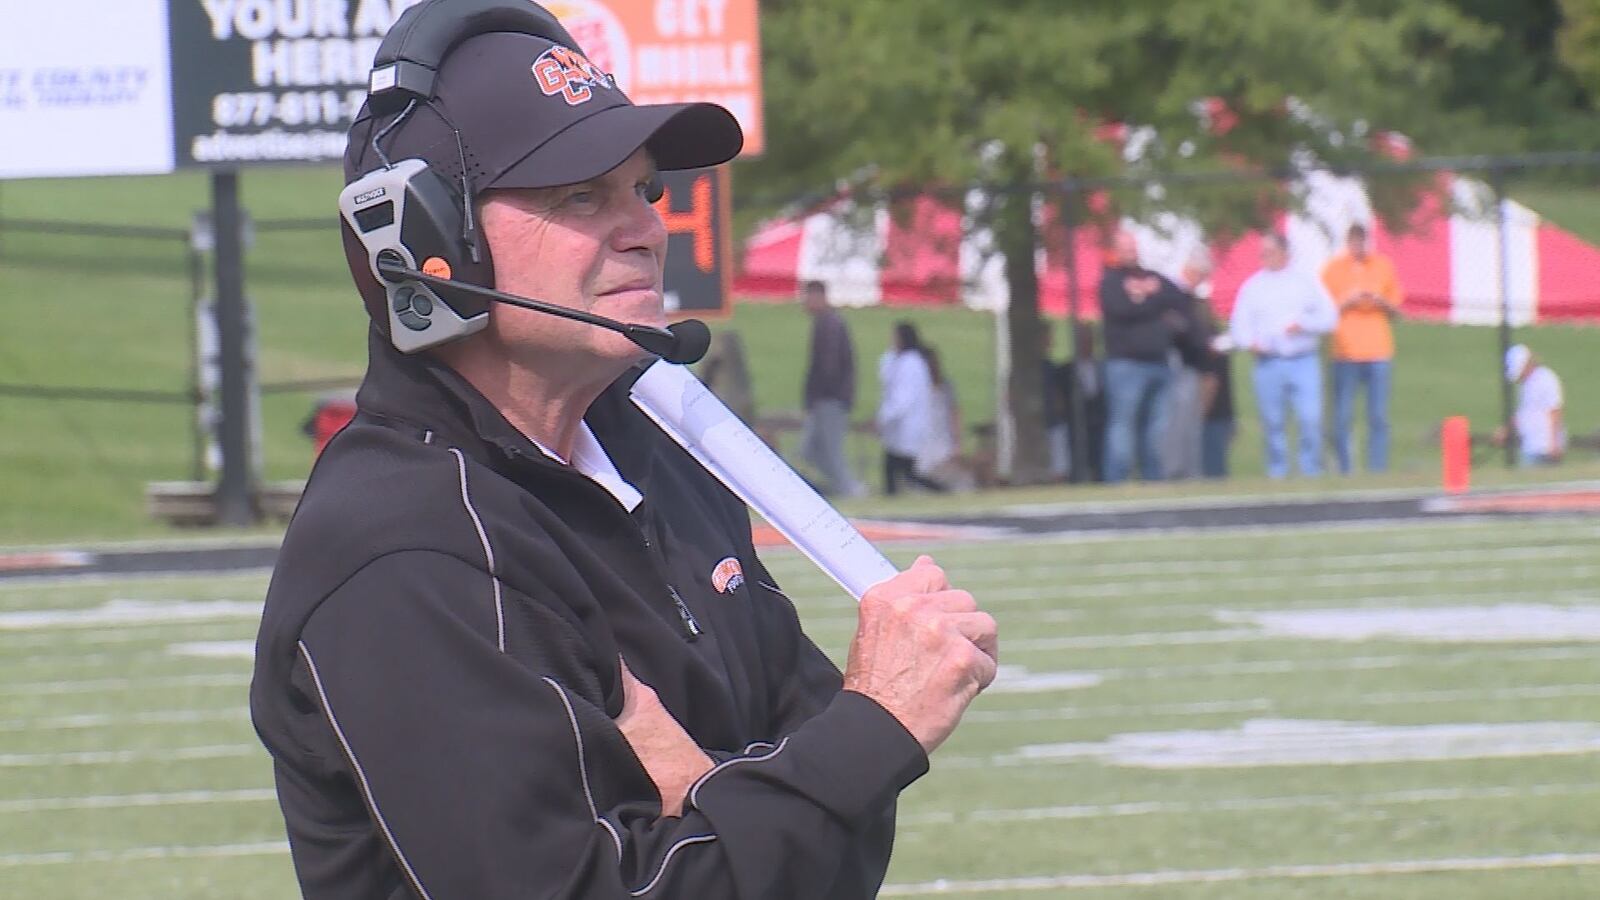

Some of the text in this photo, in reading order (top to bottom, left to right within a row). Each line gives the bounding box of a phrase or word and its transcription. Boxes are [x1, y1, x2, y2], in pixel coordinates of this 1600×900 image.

[203, 0, 347, 39] YOUR
[654, 0, 725, 37] GET
[252, 39, 383, 87] HERE
[653, 175, 714, 274] 4
